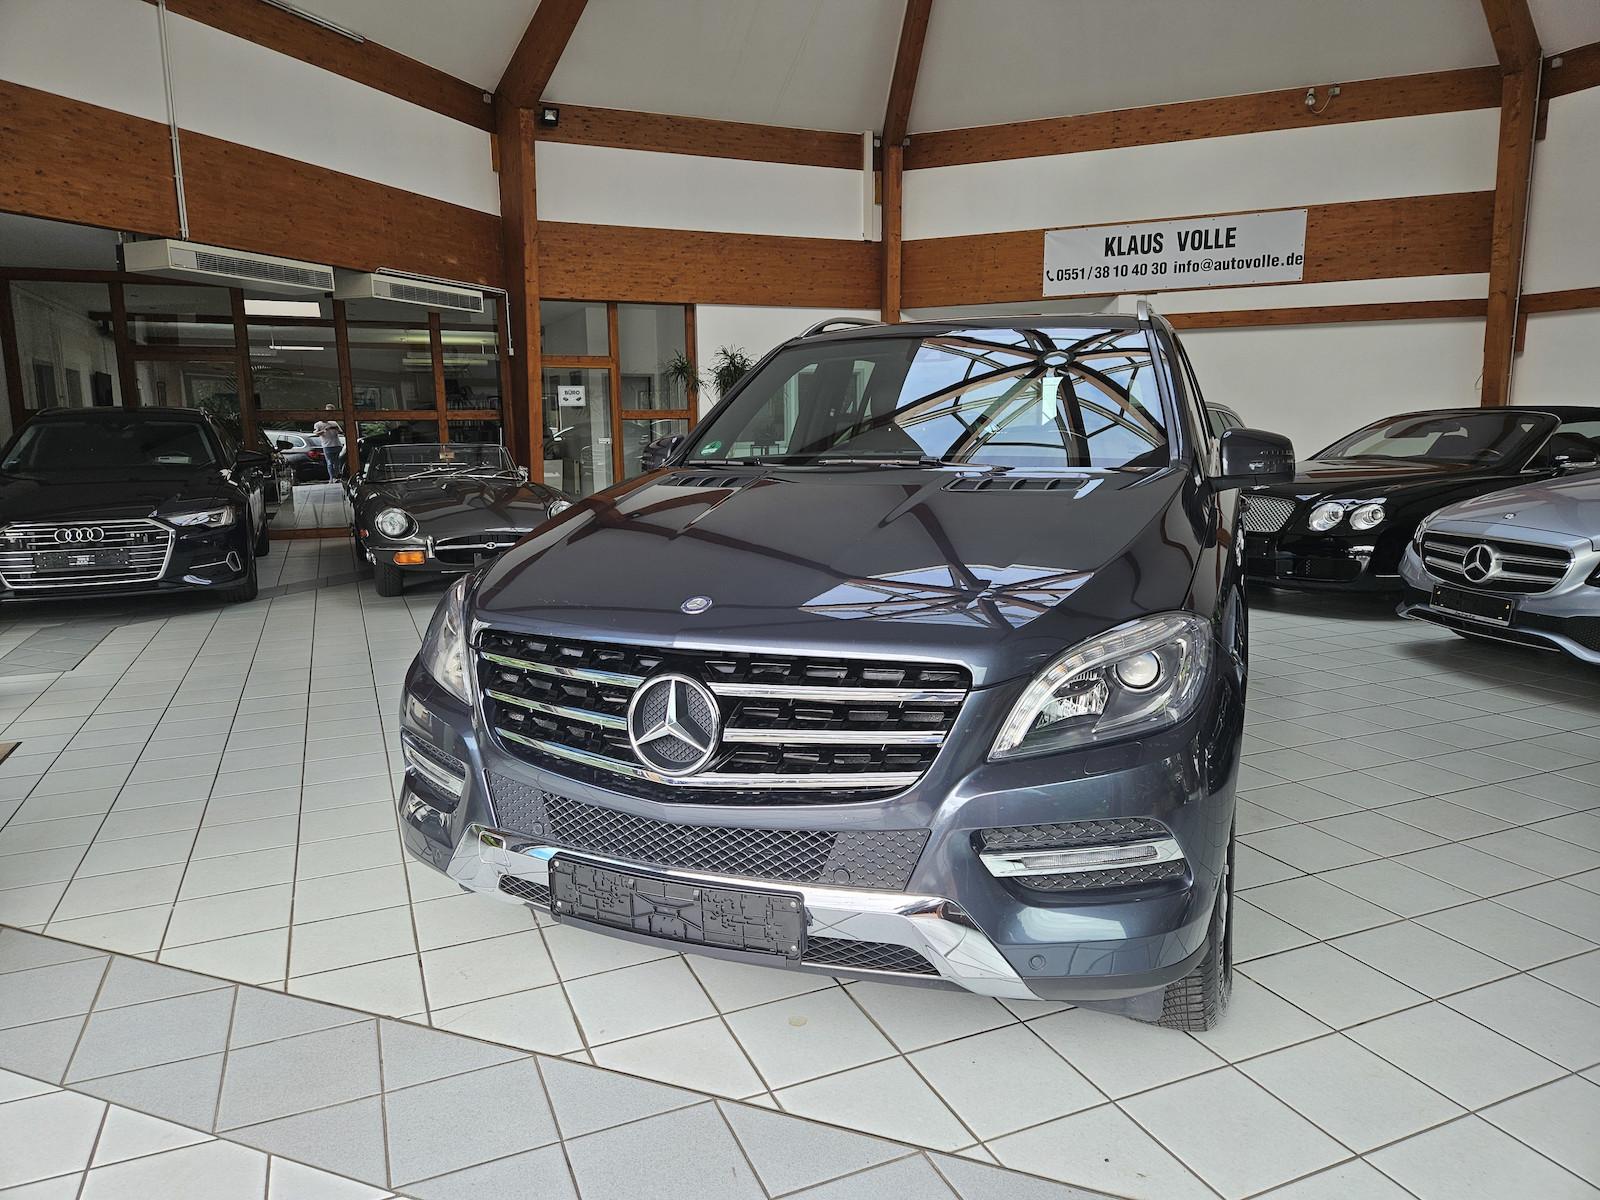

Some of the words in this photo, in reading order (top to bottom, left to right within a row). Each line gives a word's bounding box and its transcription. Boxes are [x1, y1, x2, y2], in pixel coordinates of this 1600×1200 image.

[1104, 232, 1164, 257] KLAUS
[1177, 227, 1237, 251] VOLLE
[1113, 264, 1128, 277] 10
[1131, 263, 1148, 276] 40
[1151, 262, 1168, 274] 30
[1173, 252, 1303, 274] info@autovolle.de
